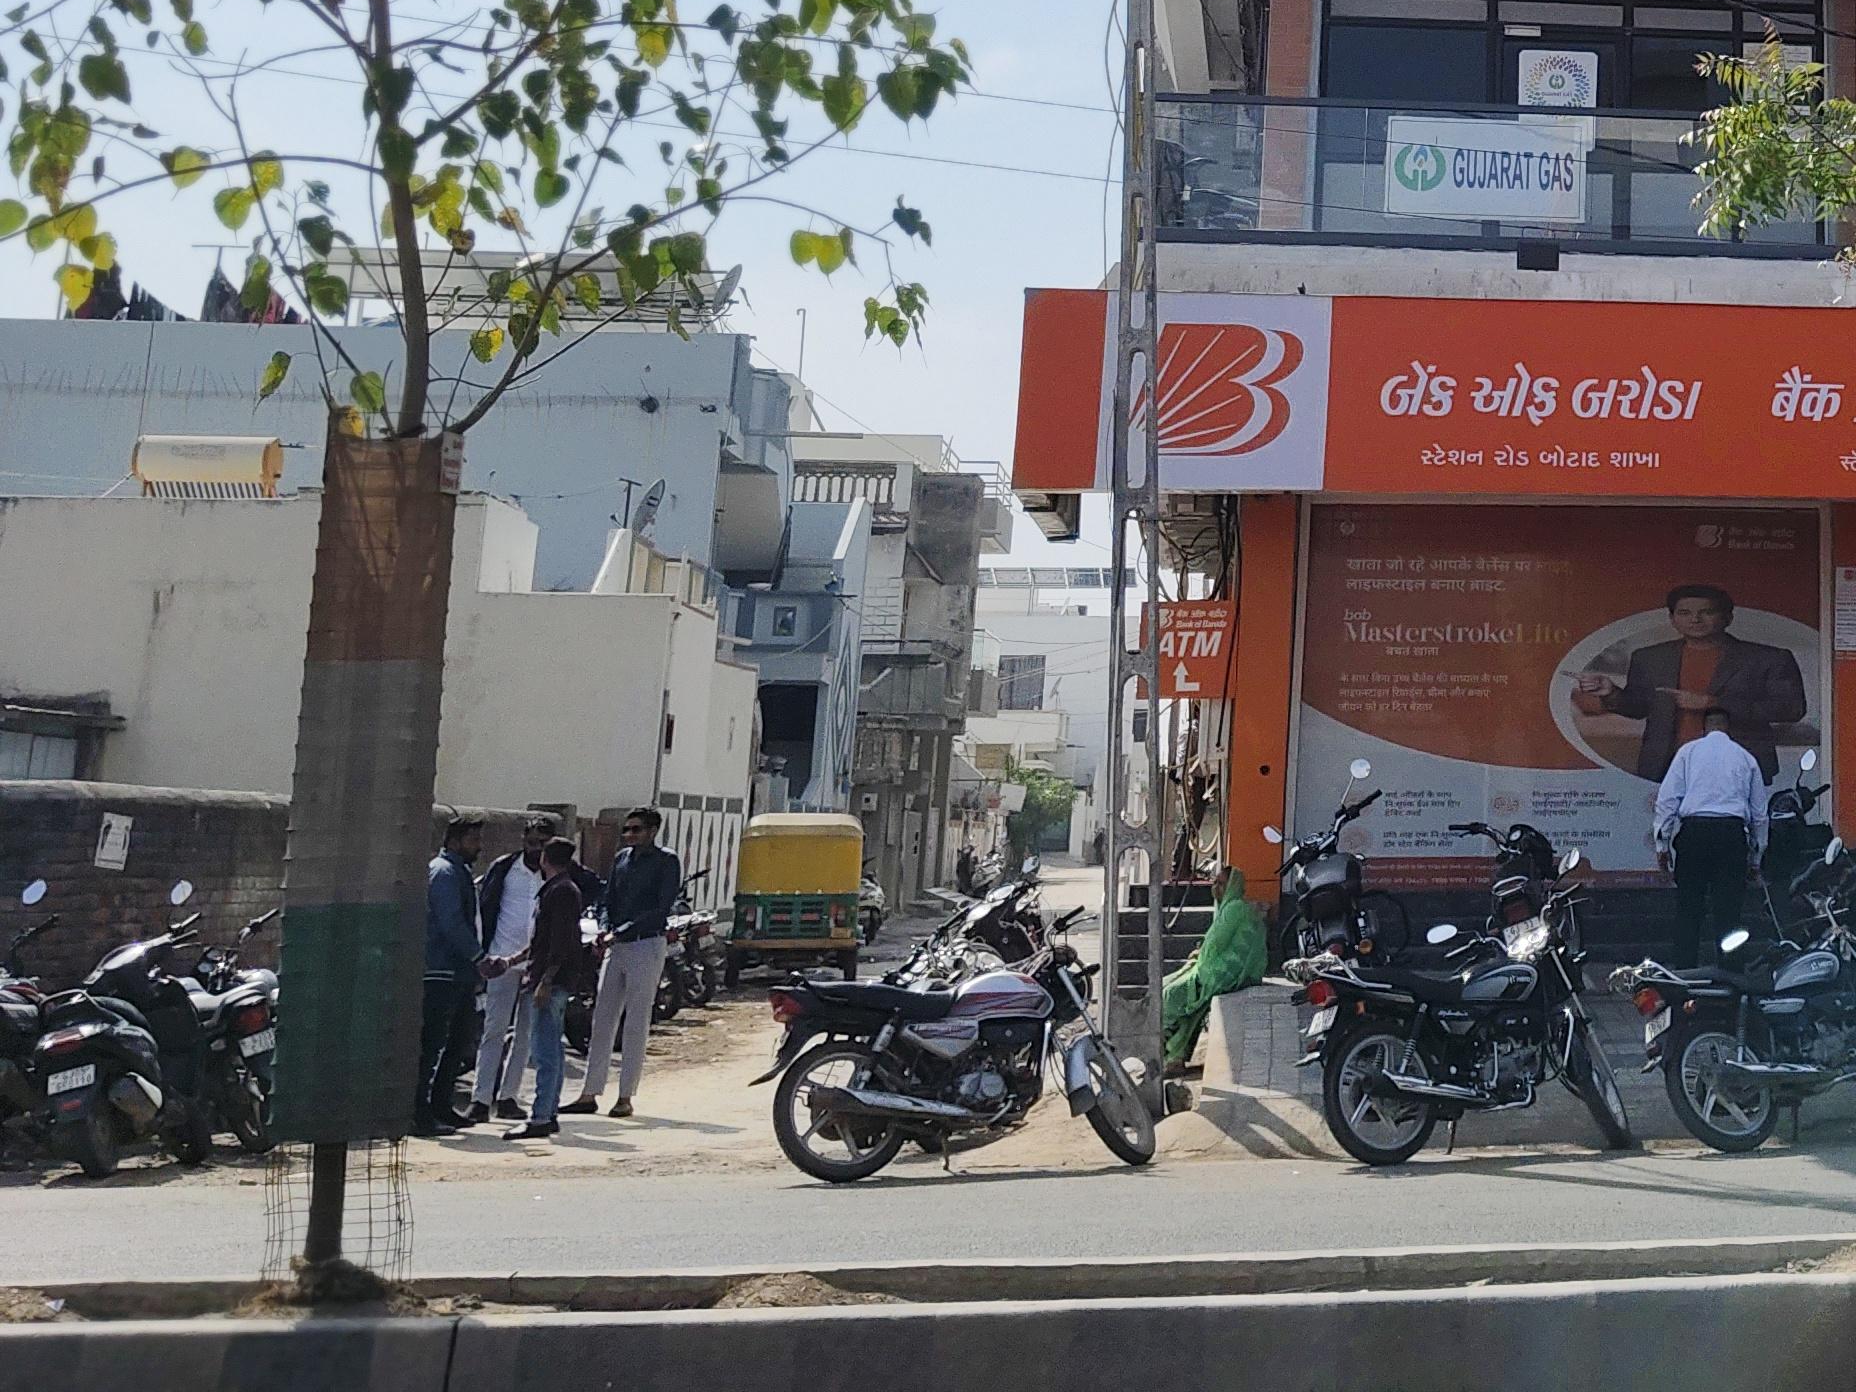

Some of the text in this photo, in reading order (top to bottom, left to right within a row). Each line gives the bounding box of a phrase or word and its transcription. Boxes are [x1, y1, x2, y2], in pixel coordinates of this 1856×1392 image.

[1453, 148, 1574, 192] GUJARAT GAS
[1380, 360, 1702, 427] બેંક ઓફ બરોડા
[1771, 365, 1846, 422] बैंक
[1420, 443, 1660, 469] સ્ટેશન રોડ બોટાદ શાખા
[1346, 559, 1382, 571] खाता
[1343, 607, 1372, 621] bob
[1159, 631, 1222, 658] ATM
